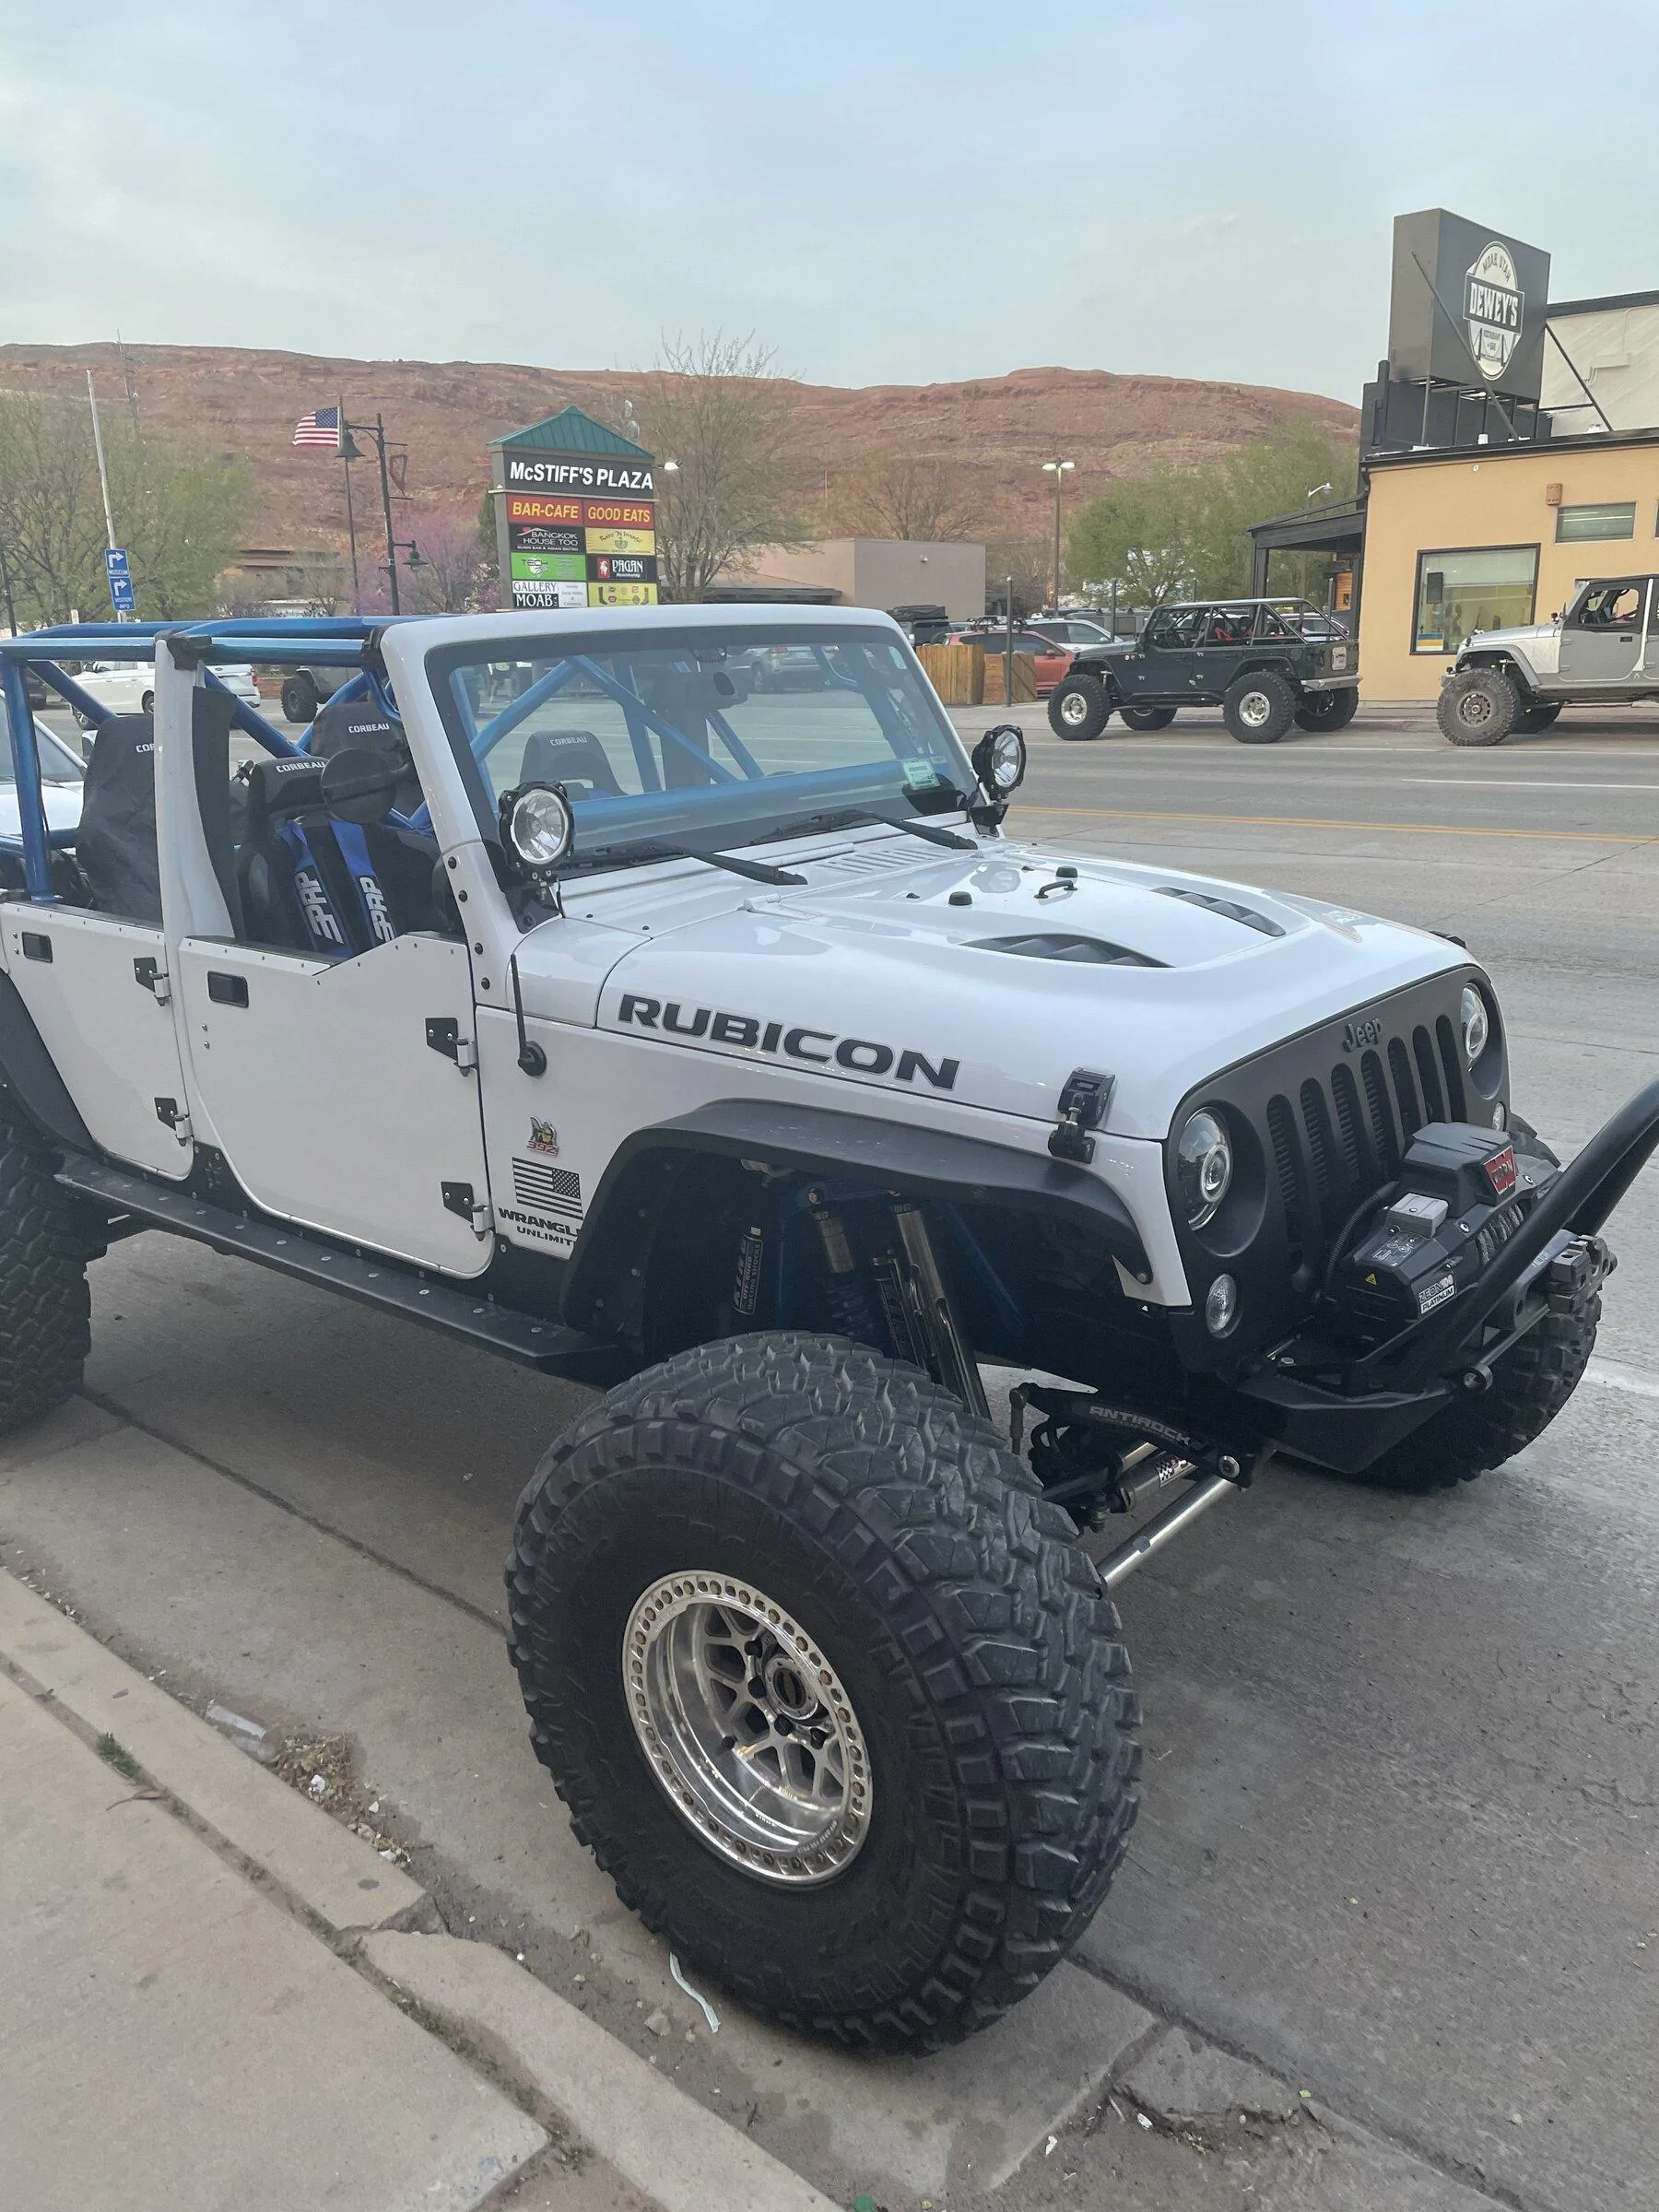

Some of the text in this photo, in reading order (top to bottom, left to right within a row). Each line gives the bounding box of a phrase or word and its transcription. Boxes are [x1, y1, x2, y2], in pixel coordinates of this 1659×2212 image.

[1469, 282, 1519, 327] DEWEY'S
[510, 462, 653, 489] McSTIFF'S PLAZA
[512, 502, 579, 519] BAR-CAFE
[588, 506, 651, 523] GOOD EATS
[523, 537, 555, 546] HOUSE
[612, 559, 643, 572] PAGAN
[513, 582, 557, 593] GALLERY
[516, 594, 553, 606] MOAB
[348, 724, 390, 734] CORBEAU
[136, 743, 155, 753] COR
[549, 736, 588, 746] CORBEAU
[276, 761, 325, 773] CORBEAU
[295, 872, 345, 944] PRP
[359, 877, 395, 942] PRP
[618, 994, 962, 1090] RUBICON
[1344, 1018, 1382, 1052] Jeep
[525, 1140, 559, 1158] 392
[499, 1207, 582, 1237] WRANGL
[517, 1226, 576, 1246] UNLIMIT
[1421, 1286, 1454, 1312] PLATINUM
[1089, 1405, 1192, 1446] ANTIROCK
